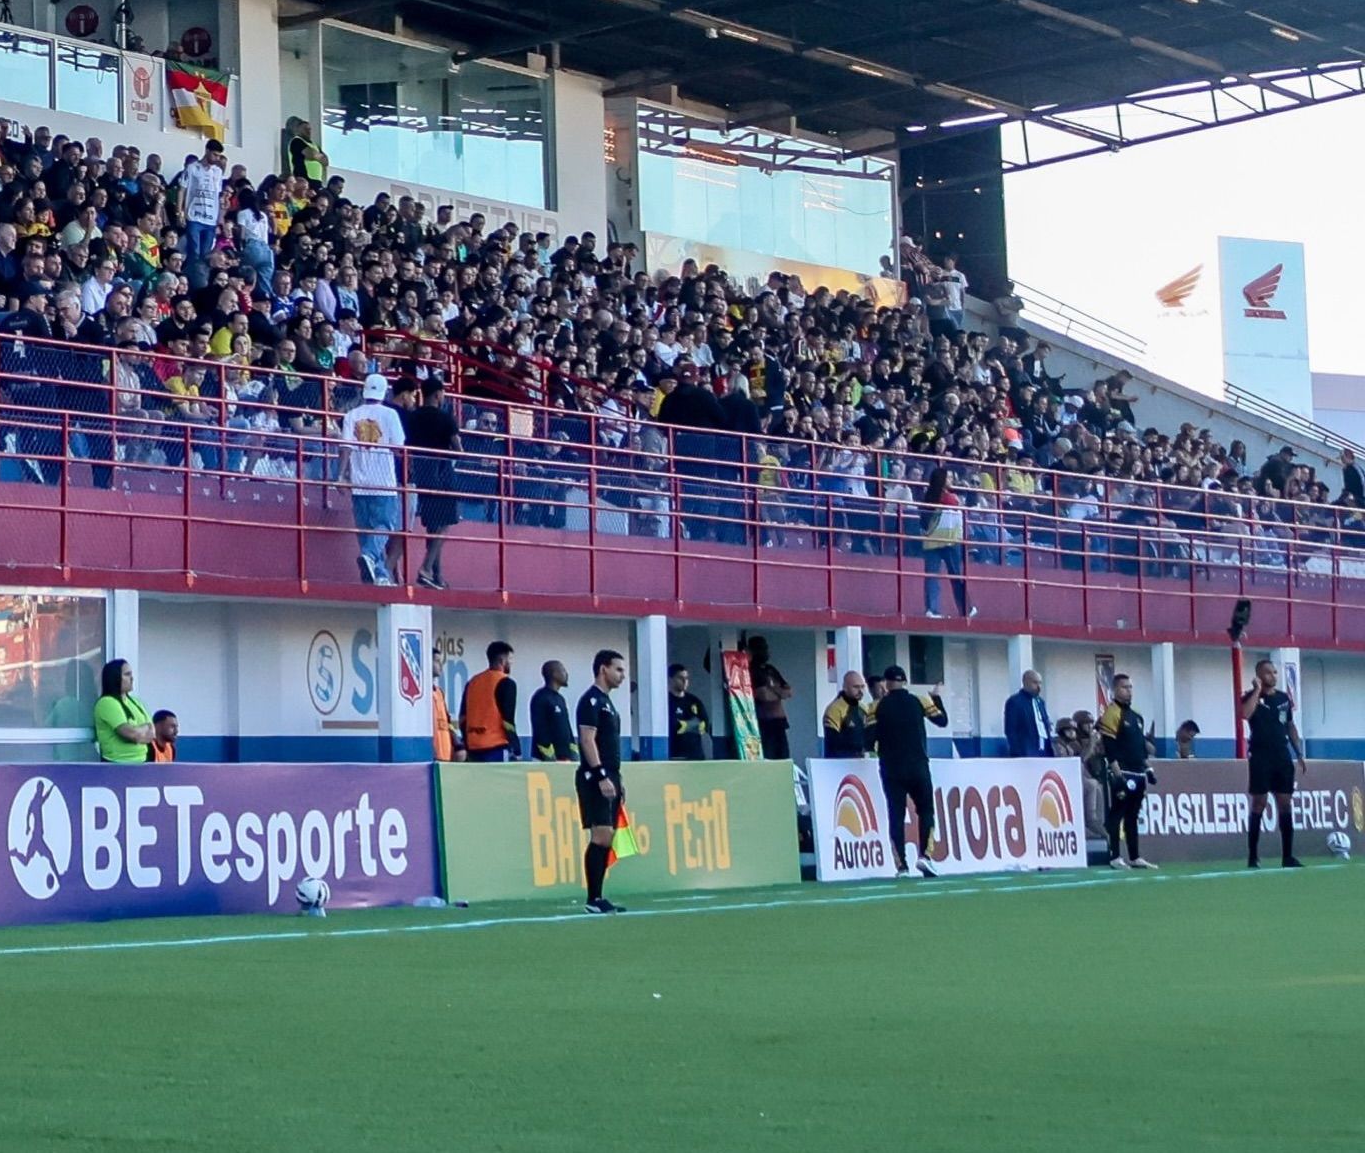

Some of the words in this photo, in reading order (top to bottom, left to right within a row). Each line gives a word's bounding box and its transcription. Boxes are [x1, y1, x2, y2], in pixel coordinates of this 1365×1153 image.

[435, 631, 464, 664] ojas
[1137, 792, 1277, 836] BRASILEIRO
[1292, 782, 1333, 830] ÉRIE
[1334, 789, 1349, 829] C
[80, 784, 409, 906] BETesporte
[833, 836, 885, 871] Aurora
[1036, 827, 1078, 859] Aurora
